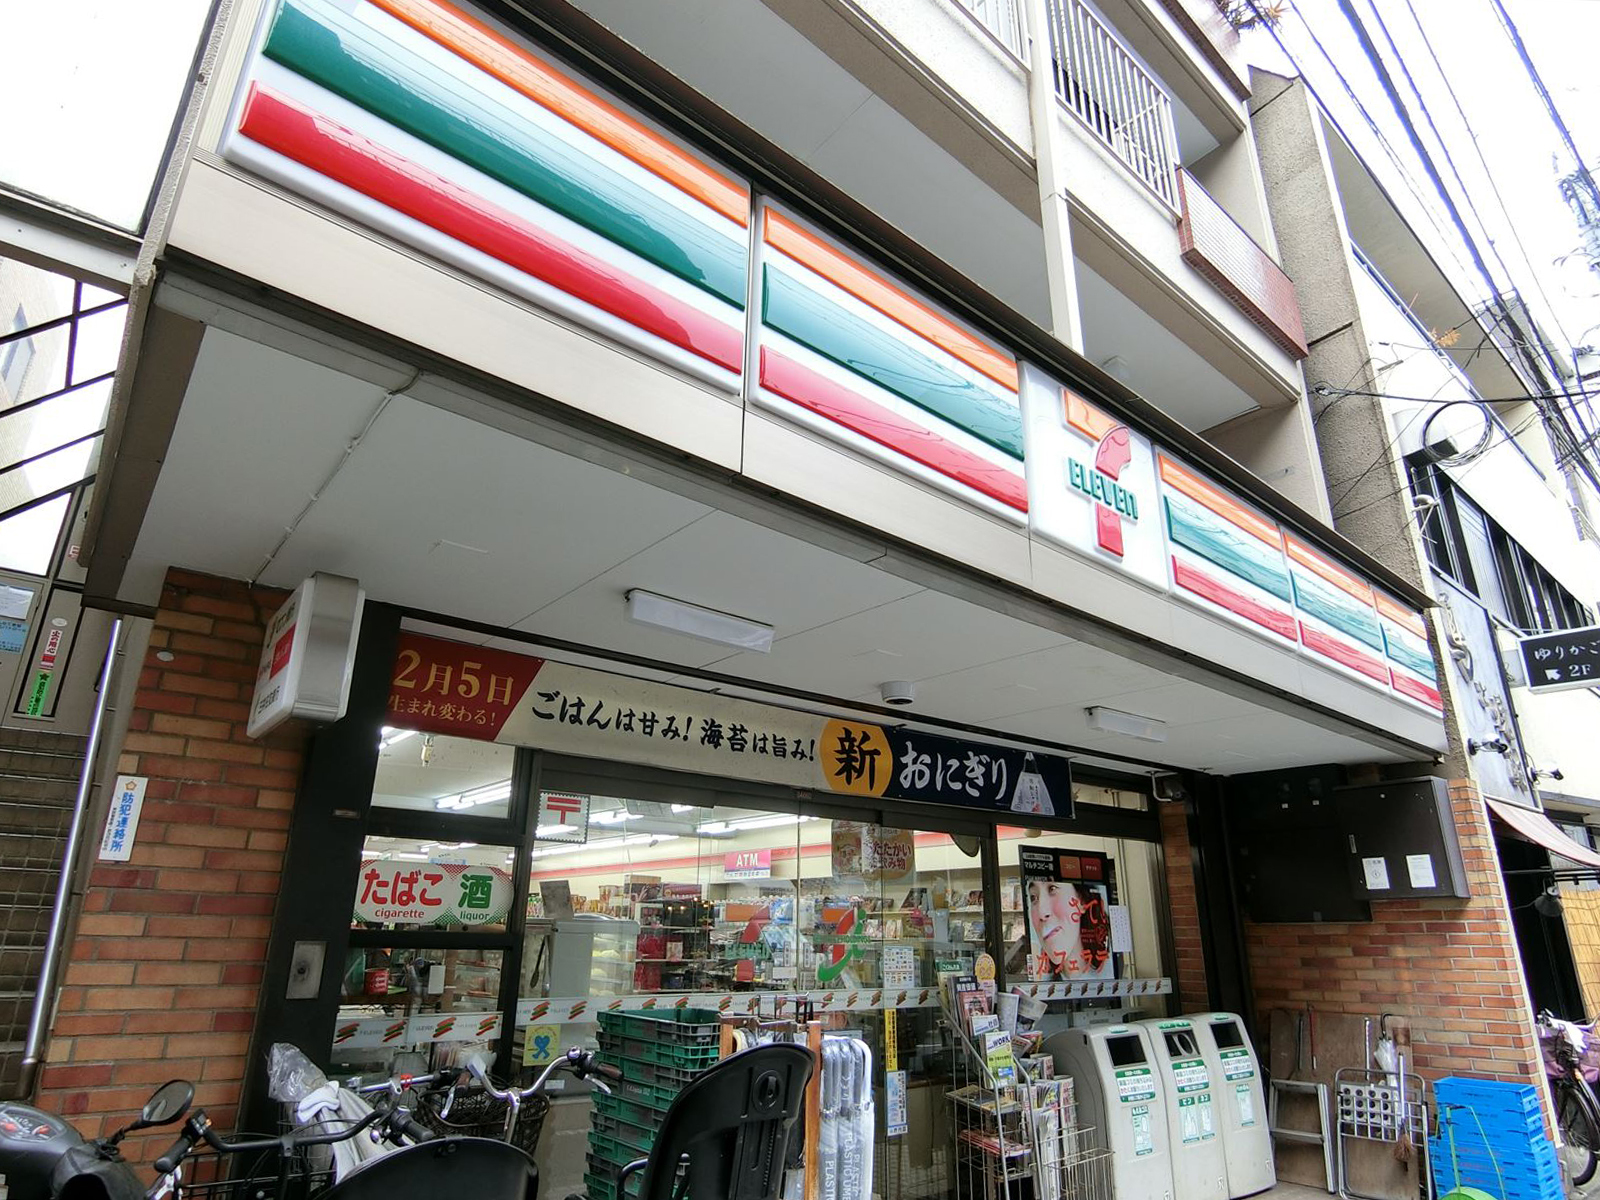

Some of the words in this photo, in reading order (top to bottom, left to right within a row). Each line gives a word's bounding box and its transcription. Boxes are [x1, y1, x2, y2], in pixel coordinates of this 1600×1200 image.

[393, 650, 515, 706] 2月5日
[1568, 664, 1591, 677] 2F
[389, 695, 496, 726] 生まれ変わる!
[833, 726, 882, 791] 新
[899, 740, 1008, 801] おにぎり
[110, 791, 135, 853] 防犯連絡所
[736, 853, 759, 867] ATM
[360, 868, 444, 907] たばこ
[458, 873, 494, 909] 酒
[374, 908, 425, 919] cigarette
[459, 910, 490, 921] liquor
[1036, 949, 1109, 979] カフェラテ
